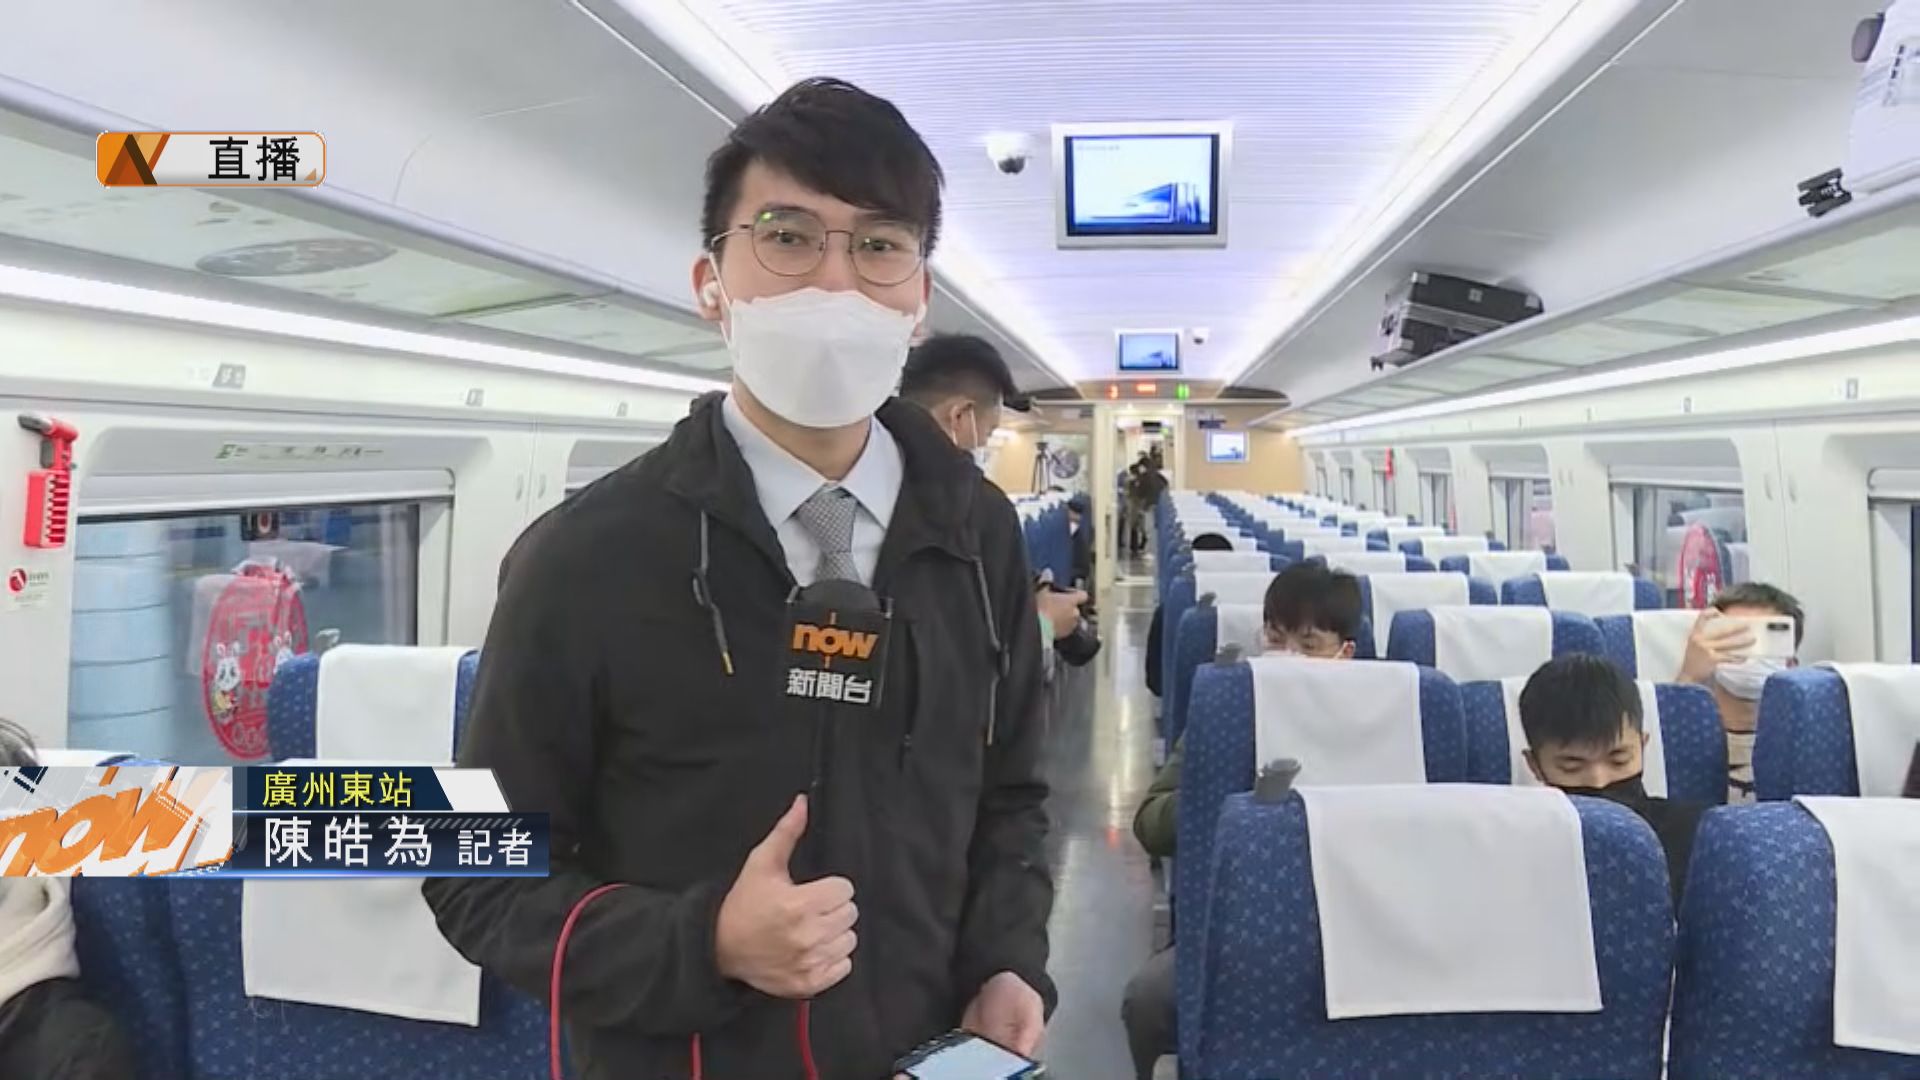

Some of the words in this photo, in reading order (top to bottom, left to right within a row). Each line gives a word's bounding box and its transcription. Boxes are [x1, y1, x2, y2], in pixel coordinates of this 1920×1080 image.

[791, 622, 880, 661] now
[786, 667, 873, 704] 新聞台
